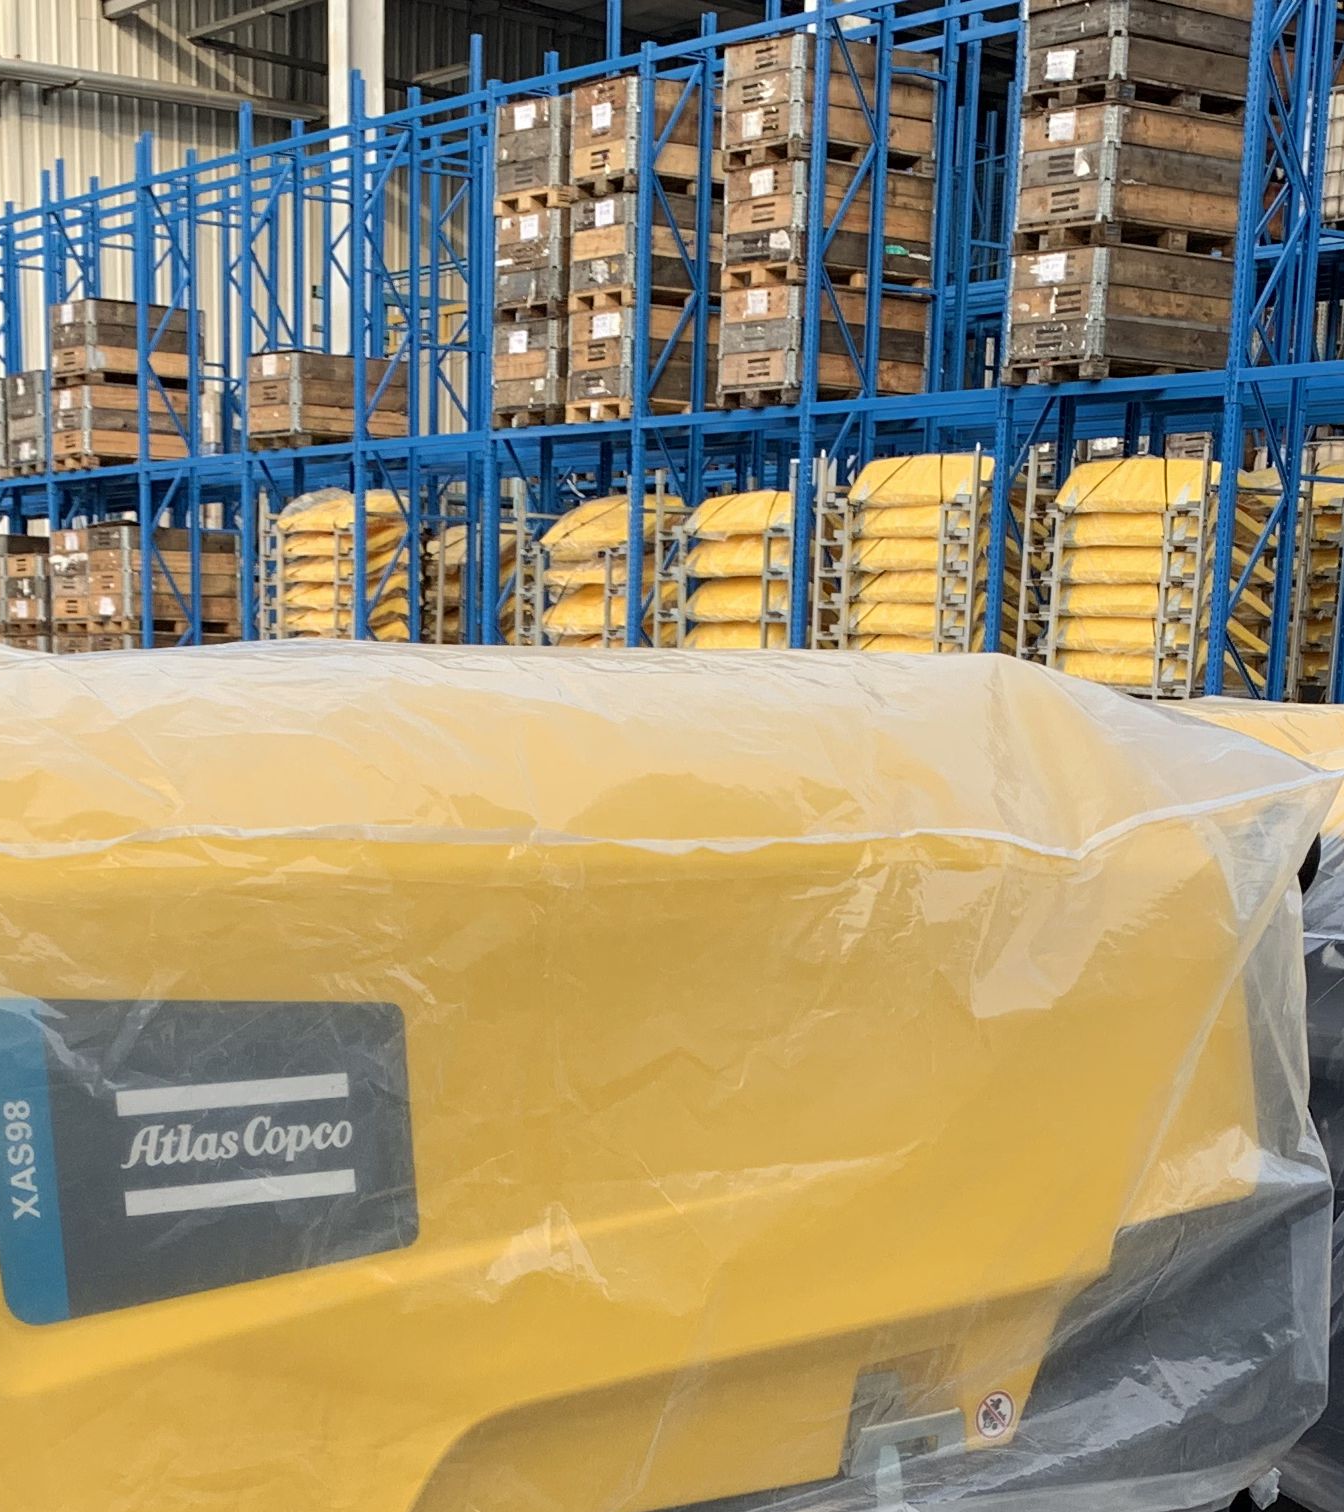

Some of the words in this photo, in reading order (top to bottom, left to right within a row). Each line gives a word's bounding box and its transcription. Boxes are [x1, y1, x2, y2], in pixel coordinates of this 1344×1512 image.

[3, 1099, 41, 1221] XAS98
[120, 1123, 239, 1170] Atlas
[243, 1115, 353, 1162] Copco
